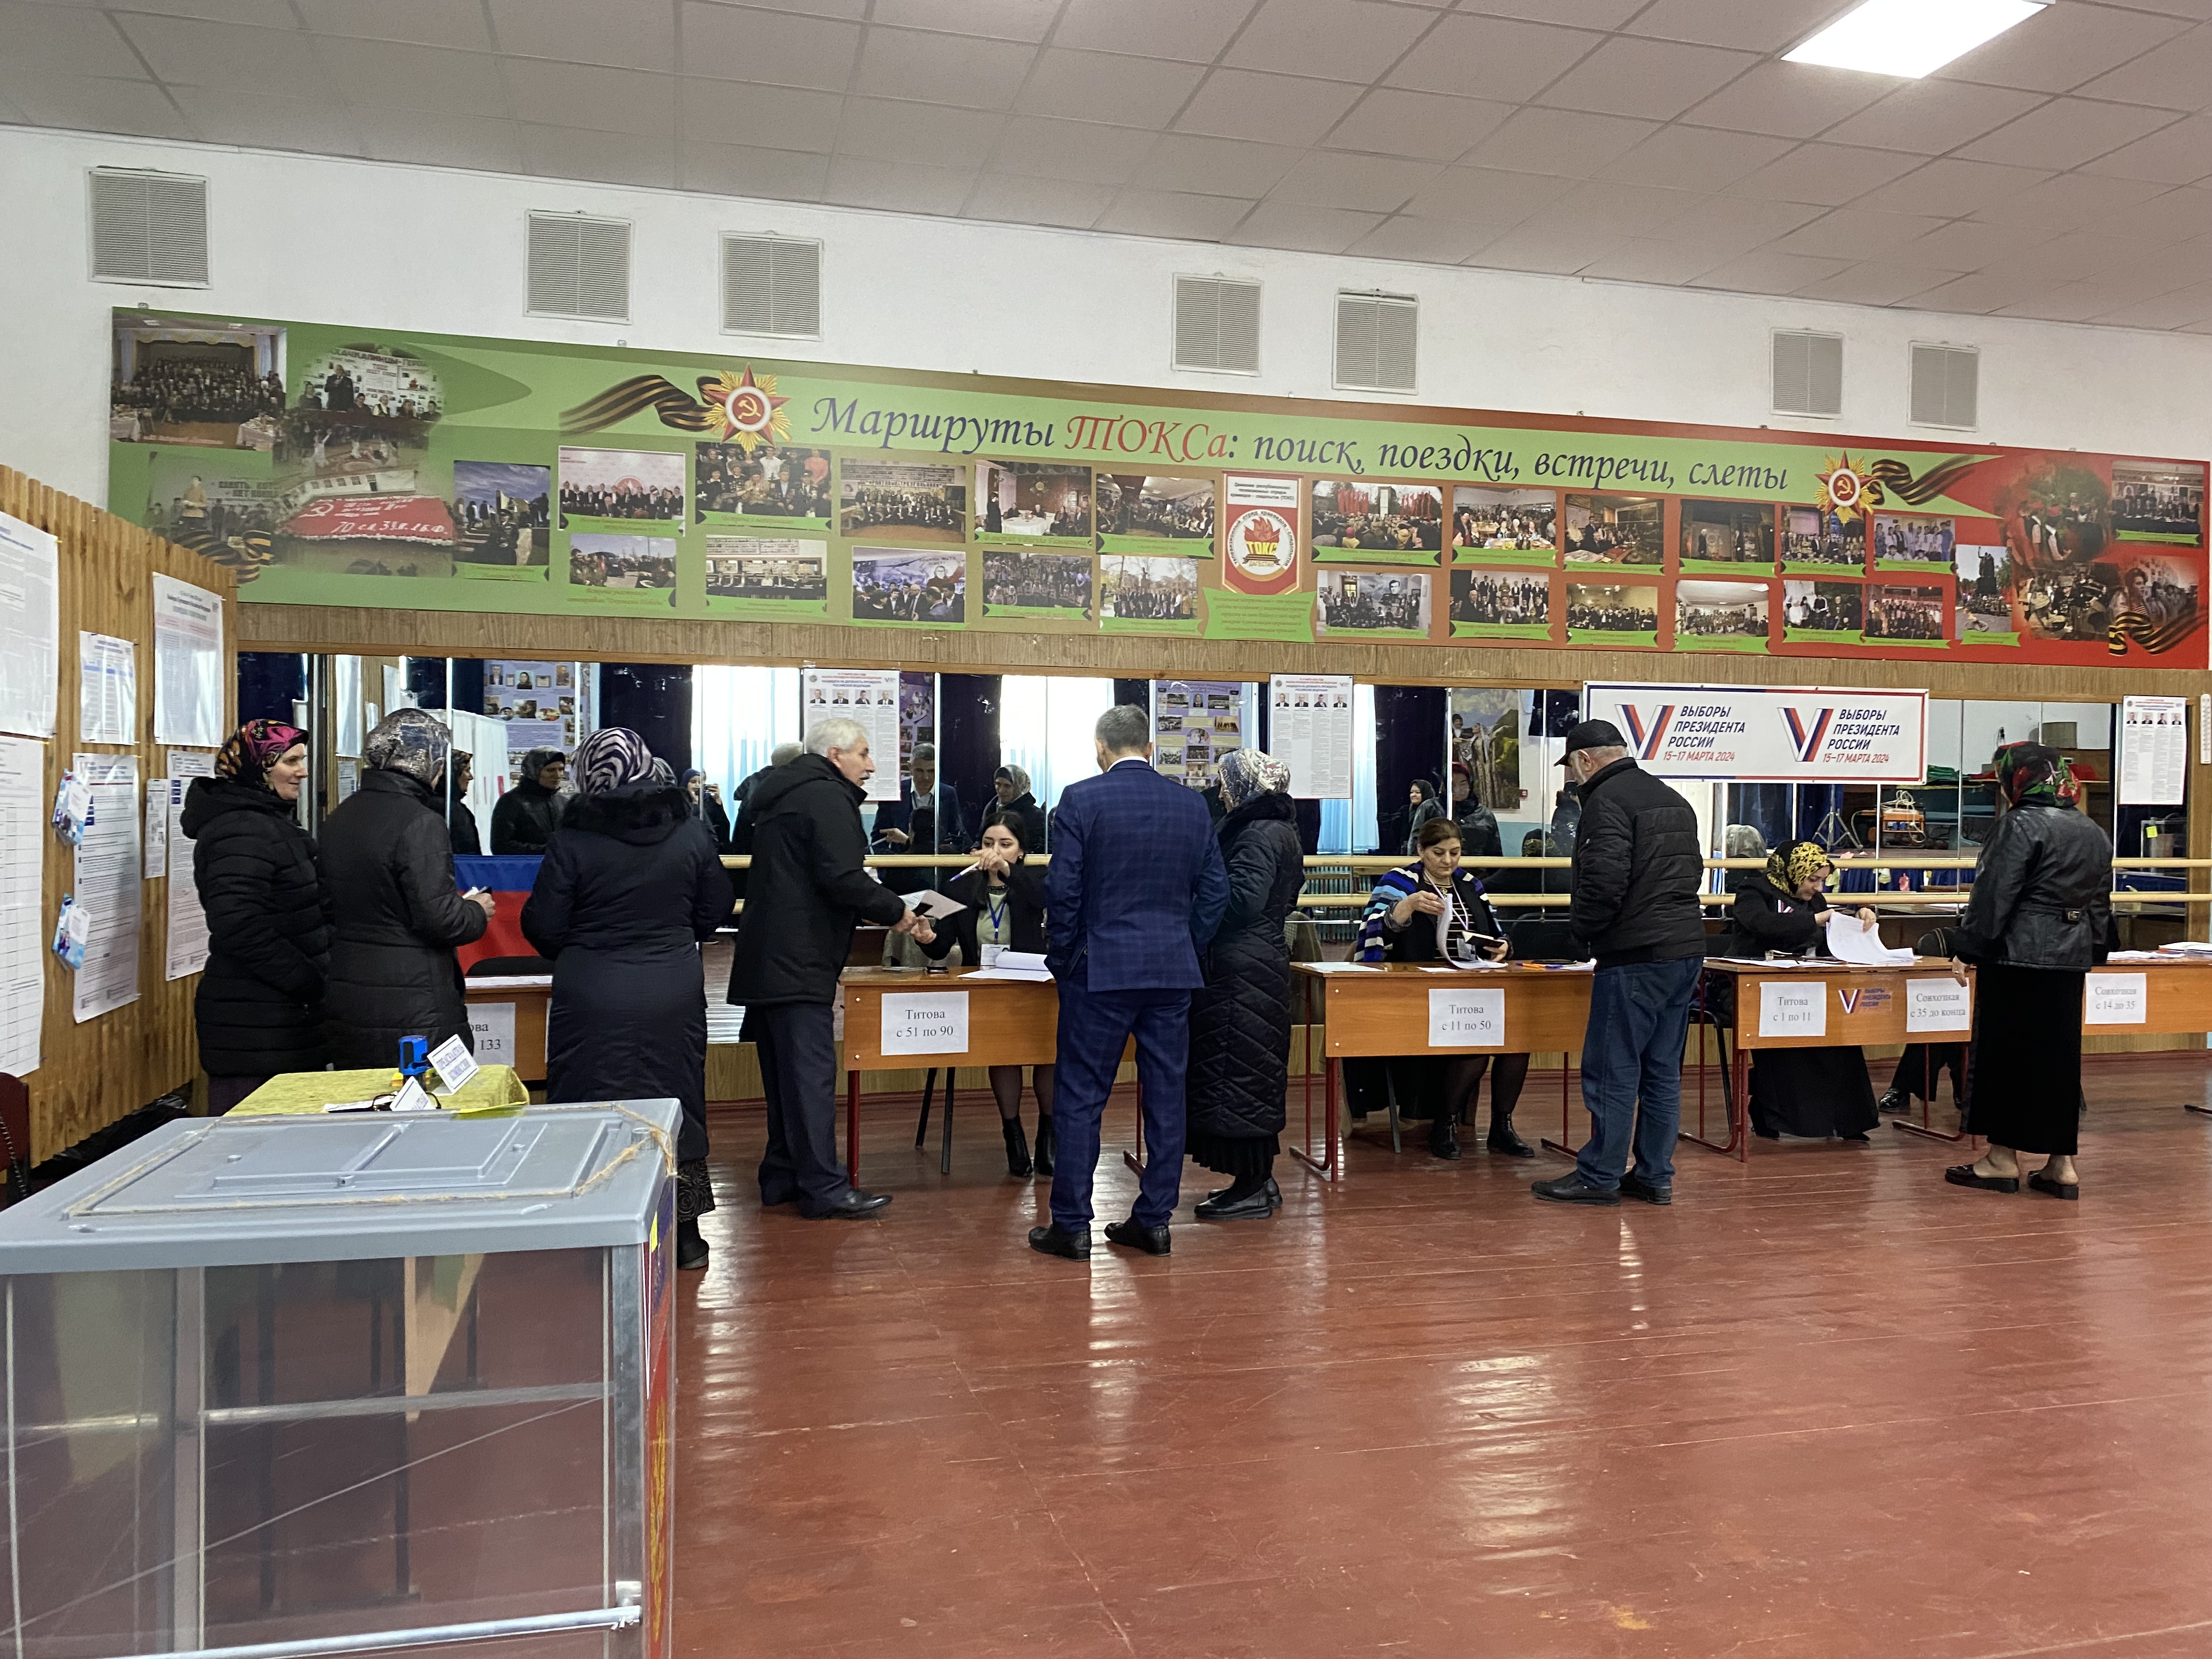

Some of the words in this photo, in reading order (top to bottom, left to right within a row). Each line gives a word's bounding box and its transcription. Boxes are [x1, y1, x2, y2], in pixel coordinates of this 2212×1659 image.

[810, 397, 1054, 454] Маршруты
[1064, 415, 1238, 463] ТОКСа:
[1253, 436, 1364, 475] поиск,
[1378, 434, 1520, 482] поездки,
[1534, 451, 1675, 489] встречи,
[1689, 460, 1787, 490] слеты
[1246, 541, 1279, 555] ТОКС
[1680, 706, 1731, 717] ВЫБОРЫ
[1839, 709, 1887, 720] ВЫБОРЫ
[1674, 721, 1746, 734] ПРЕЗИДЕНТА
[1833, 724, 1900, 737] ПРЕЗИДЕНТА
[1668, 736, 1714, 748] РОССИИ
[1827, 739, 1871, 750] РОССИИ
[1686, 752, 1713, 761] МАРТА
[1715, 752, 1735, 761] 2024
[1846, 753, 1870, 763] МАРТА
[1871, 754, 1890, 763] 2024
[1778, 996, 1808, 1006] Титова
[1916, 993, 1960, 1002] Совхозная
[1448, 1005, 1484, 1014] Титова
[2125, 1001, 2135, 1009] 35
[905, 1009, 945, 1019] Титова
[1781, 1012, 1785, 1021] 1
[1802, 1012, 1810, 1021] 11
[1917, 1008, 1927, 1017] 35
[1451, 1021, 1460, 1030] 11
[1480, 1020, 1491, 1030] 50
[906, 1027, 917, 1037] 51
[940, 1025, 953, 1036] 90
[479, 1039, 500, 1050] 133
